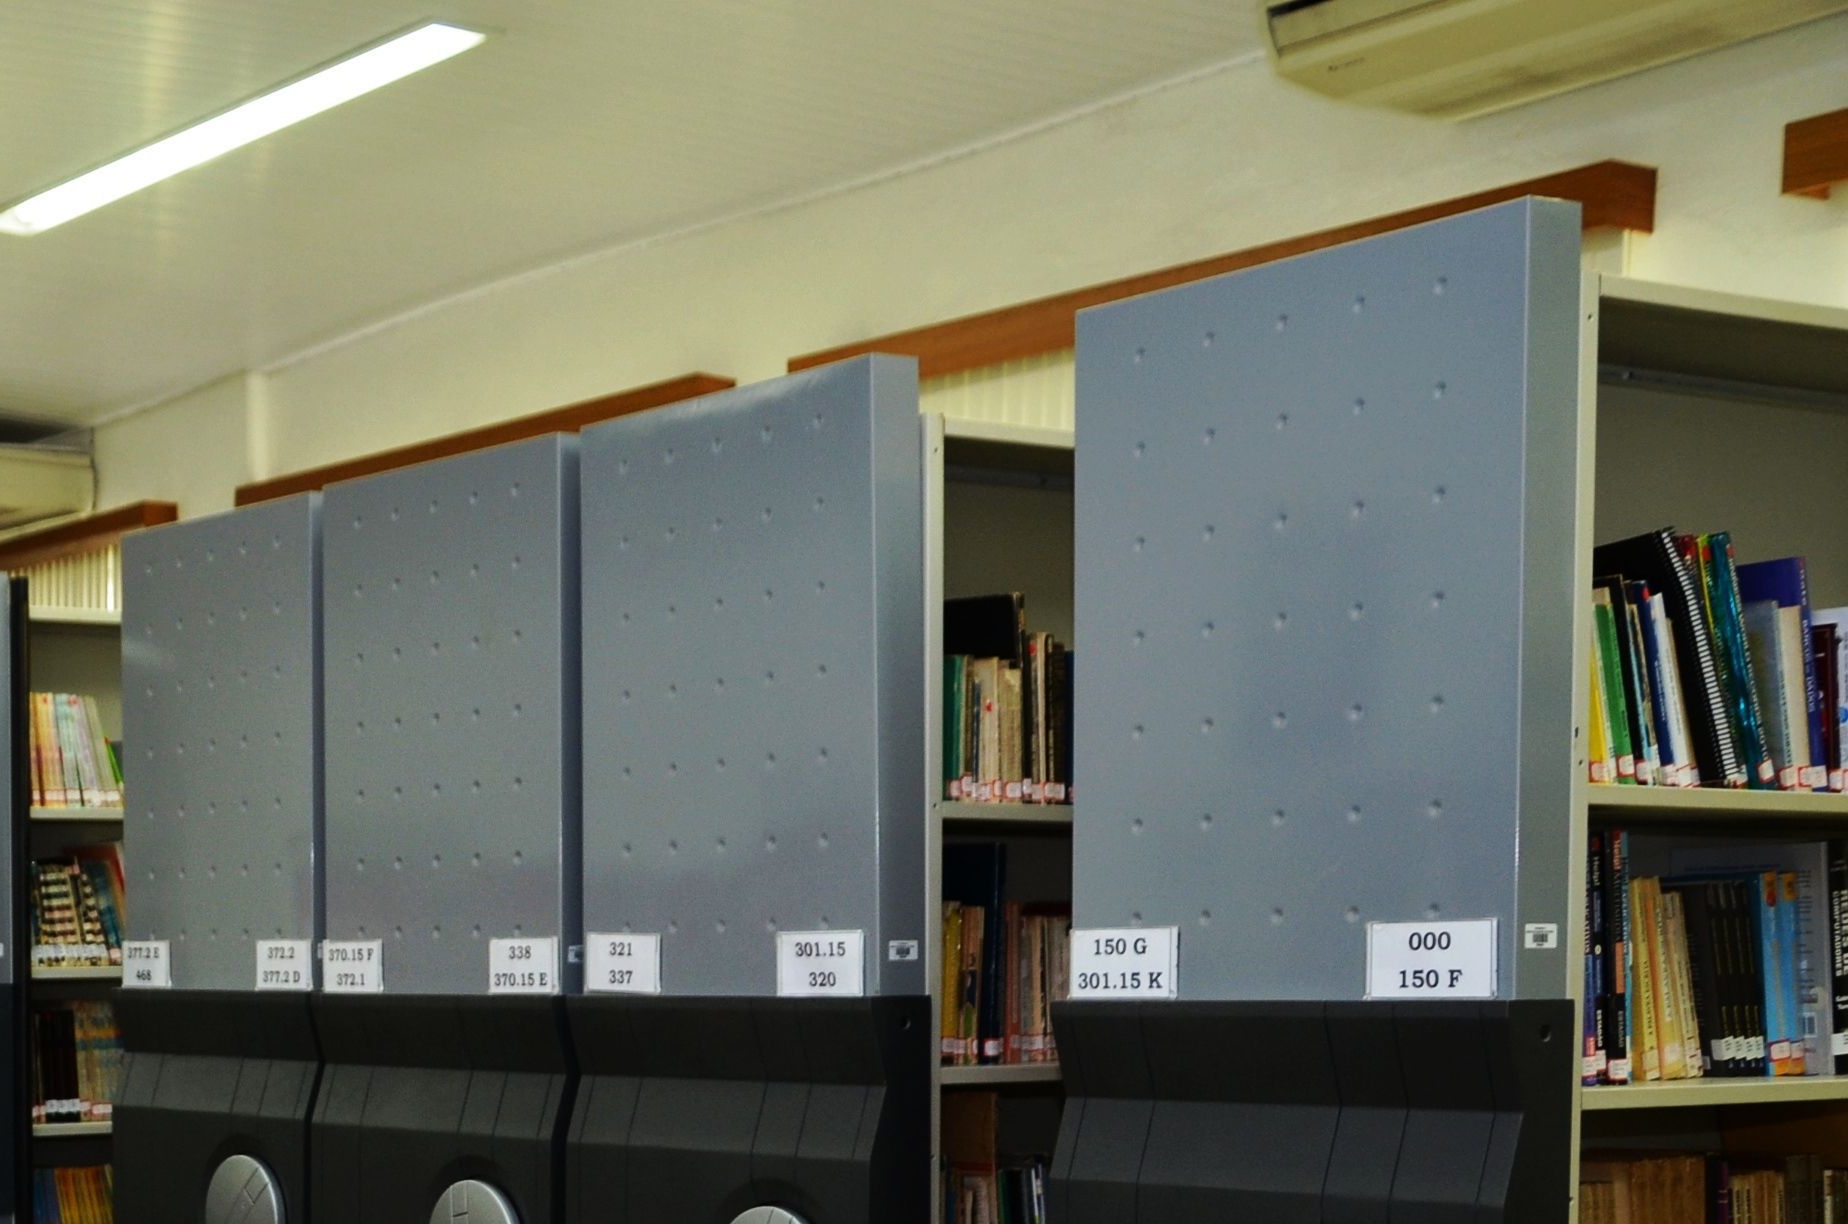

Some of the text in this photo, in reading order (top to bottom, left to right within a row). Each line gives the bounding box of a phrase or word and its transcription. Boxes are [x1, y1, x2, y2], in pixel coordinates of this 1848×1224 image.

[1832, 890, 1842, 977] COMPUTADORES
[1094, 937, 1148, 956] 150 G
[1408, 931, 1451, 951] 000
[128, 947, 152, 959] 377.2
[267, 947, 295, 959] 372.2
[328, 948, 374, 961] 370.15 F
[508, 946, 532, 959] 338
[609, 942, 632, 956] 321
[795, 942, 846, 957] 301.15
[262, 971, 301, 983] 377.2 D
[336, 973, 365, 986] 372.1
[494, 973, 548, 986] 370.15 E
[609, 971, 633, 984] 337
[809, 972, 836, 987] 320
[1078, 971, 1163, 989] 301.15 K
[1399, 969, 1463, 989] 150 F
